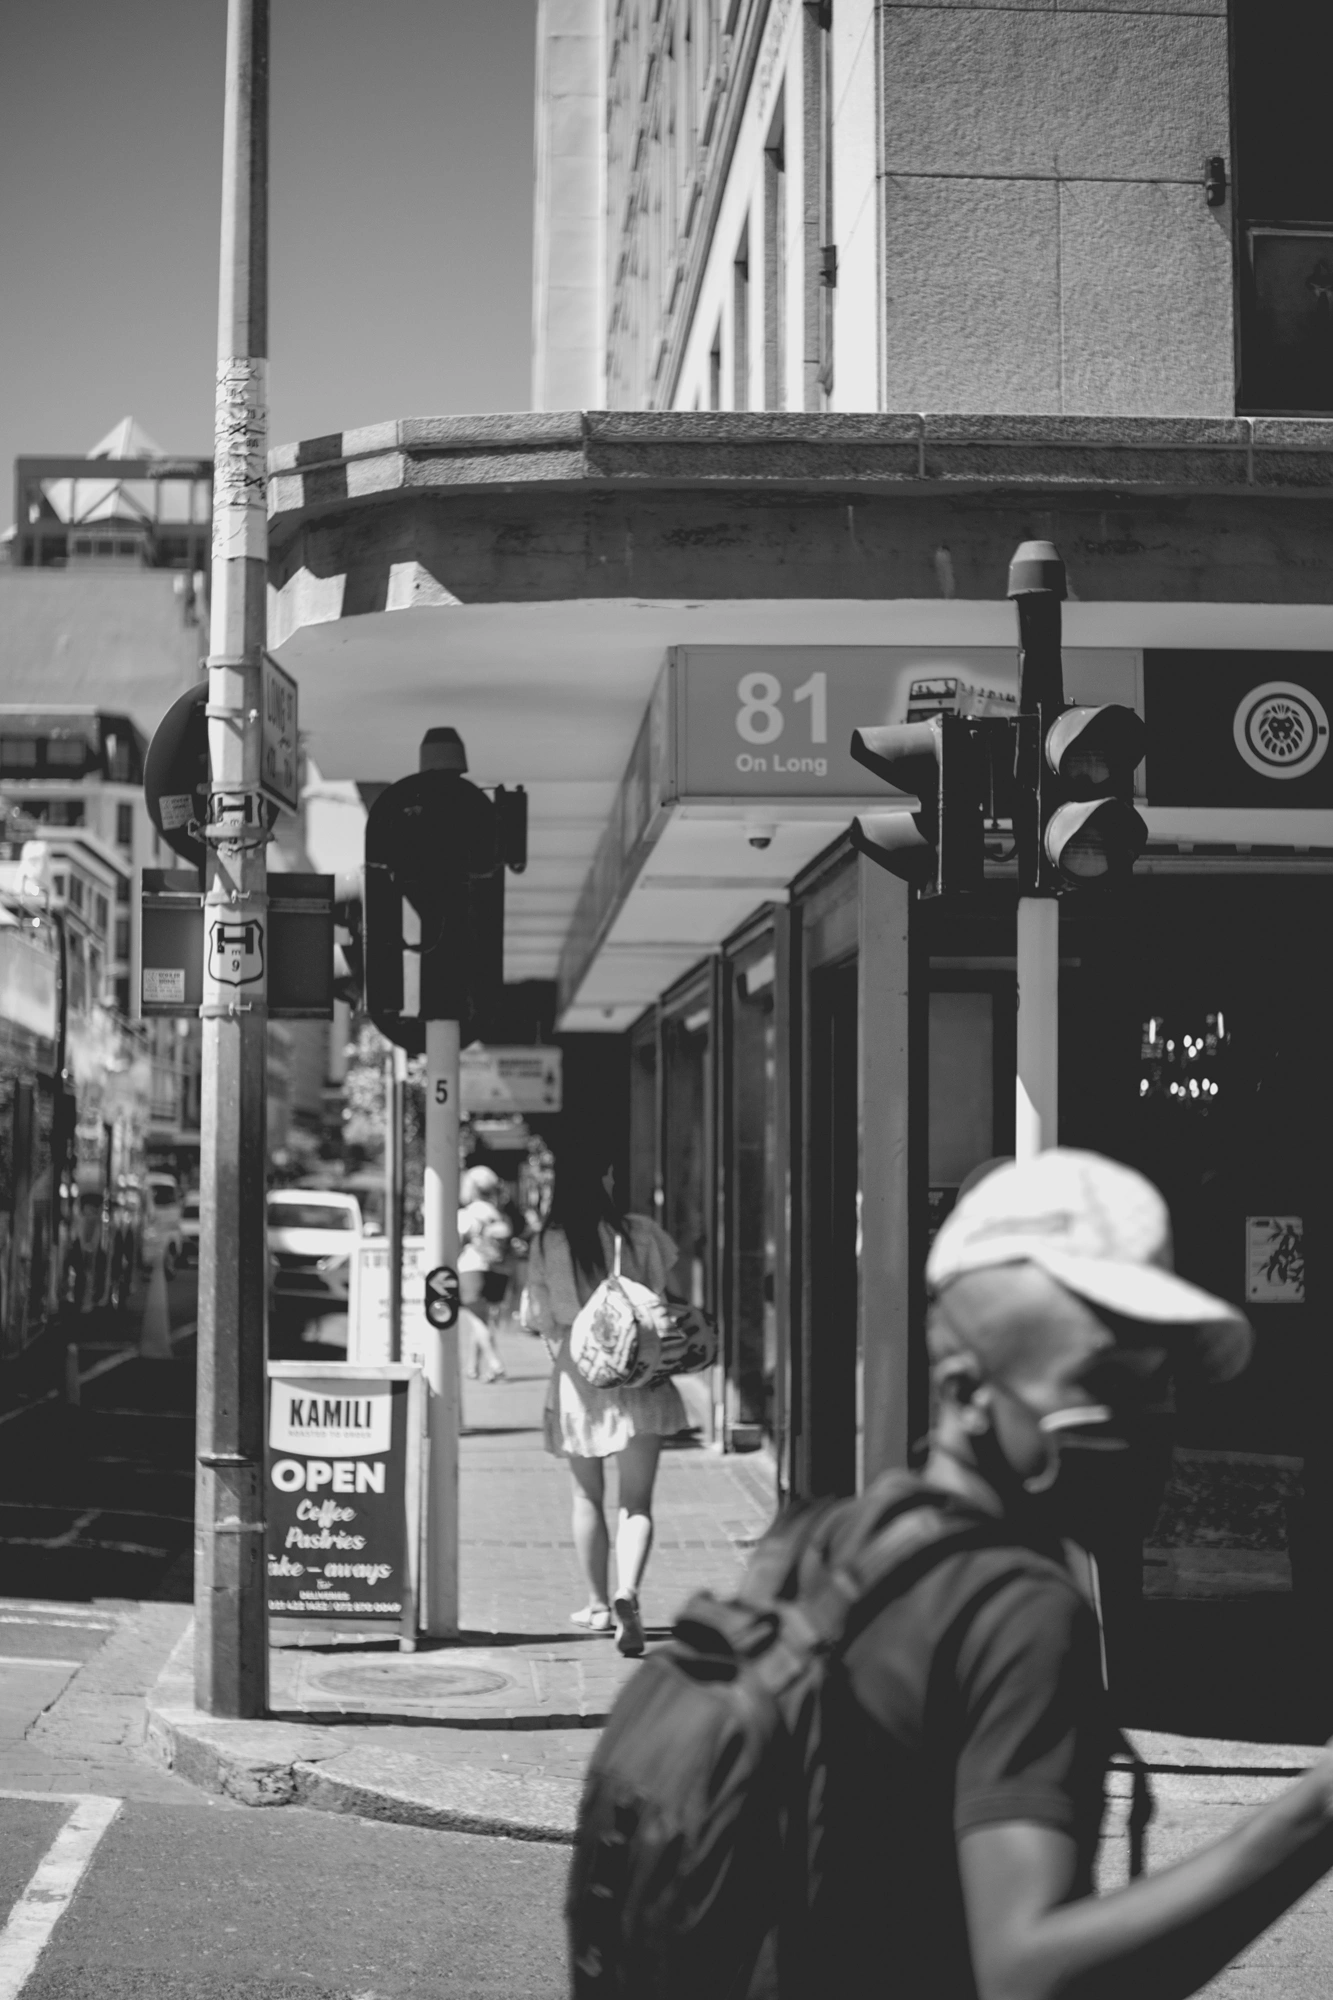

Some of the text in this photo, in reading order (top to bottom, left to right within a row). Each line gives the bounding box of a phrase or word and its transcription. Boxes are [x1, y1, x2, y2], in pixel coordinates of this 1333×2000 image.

[736, 671, 827, 745] 81
[736, 753, 828, 776] On Long
[217, 927, 254, 954] H
[231, 959, 240, 972] 9
[435, 1079, 448, 1104] 5
[289, 1398, 372, 1428] KAMILI
[270, 1458, 386, 1494] OPEN
[296, 1498, 357, 1529] Coffee
[285, 1526, 367, 1550] Pastries
